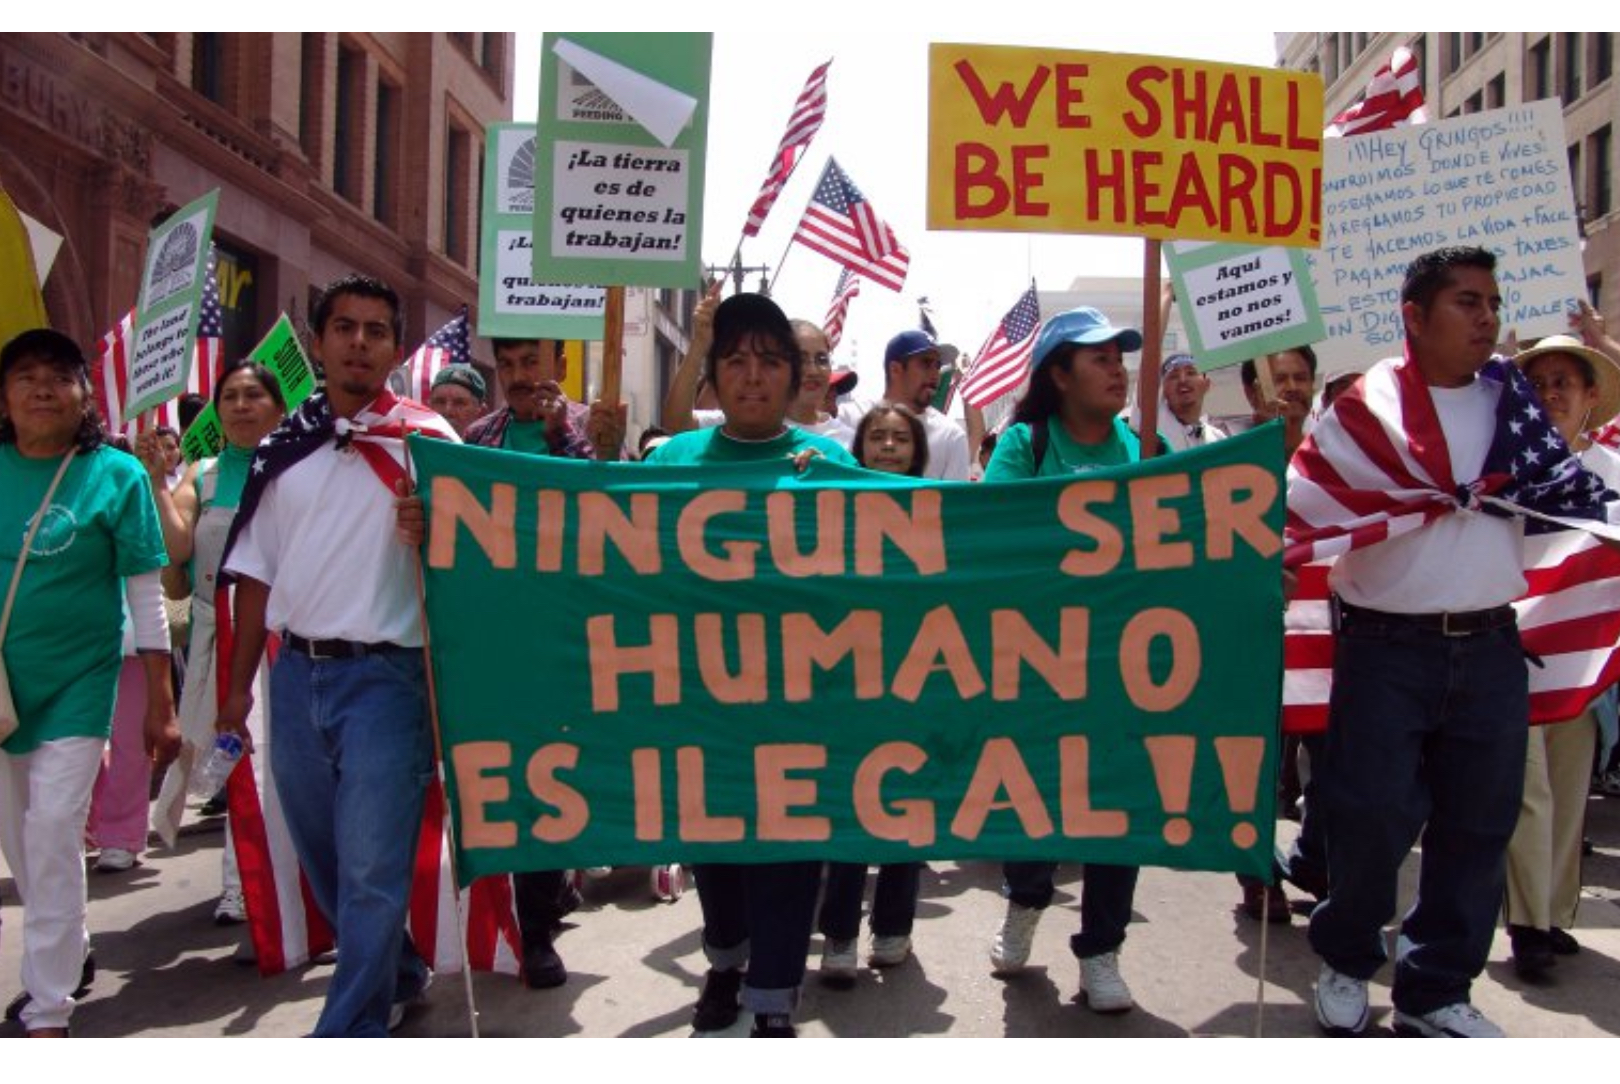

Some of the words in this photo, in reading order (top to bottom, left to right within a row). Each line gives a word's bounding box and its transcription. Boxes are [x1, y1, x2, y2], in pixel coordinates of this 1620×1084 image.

[954, 59, 1091, 129] WE
[1122, 65, 1320, 152] SHALL
[568, 150, 607, 170] ¡La
[613, 153, 681, 173] tierra
[1430, 150, 1490, 173] DONDE
[594, 181, 621, 196] es
[626, 179, 657, 198] de
[955, 142, 1050, 220] BE
[1084, 149, 1321, 242] HEARD!
[1423, 182, 1441, 195] LO
[1475, 170, 1495, 186] TE
[1436, 202, 1457, 218] TU
[1461, 180, 1557, 212] PROPIEDAD
[560, 204, 658, 225] quienes
[662, 207, 686, 225] la
[565, 230, 682, 252] trabajan!
[1325, 244, 1353, 263] TE
[1457, 225, 1479, 239] LA
[1196, 275, 1279, 307] estamos
[1282, 270, 1293, 286] y
[1333, 263, 1409, 290] PAGAMO
[506, 293, 605, 310] trabajan!
[1218, 306, 1243, 322] no
[1247, 294, 1283, 313] nos
[1220, 308, 1292, 341] vamos!
[273, 337, 310, 393] SOUTH
[428, 476, 947, 582] NINGUN
[1059, 464, 1283, 577] SER
[586, 604, 1202, 713] HUMANO
[451, 740, 590, 848] ES
[632, 735, 1267, 849] ILEGAL!!
